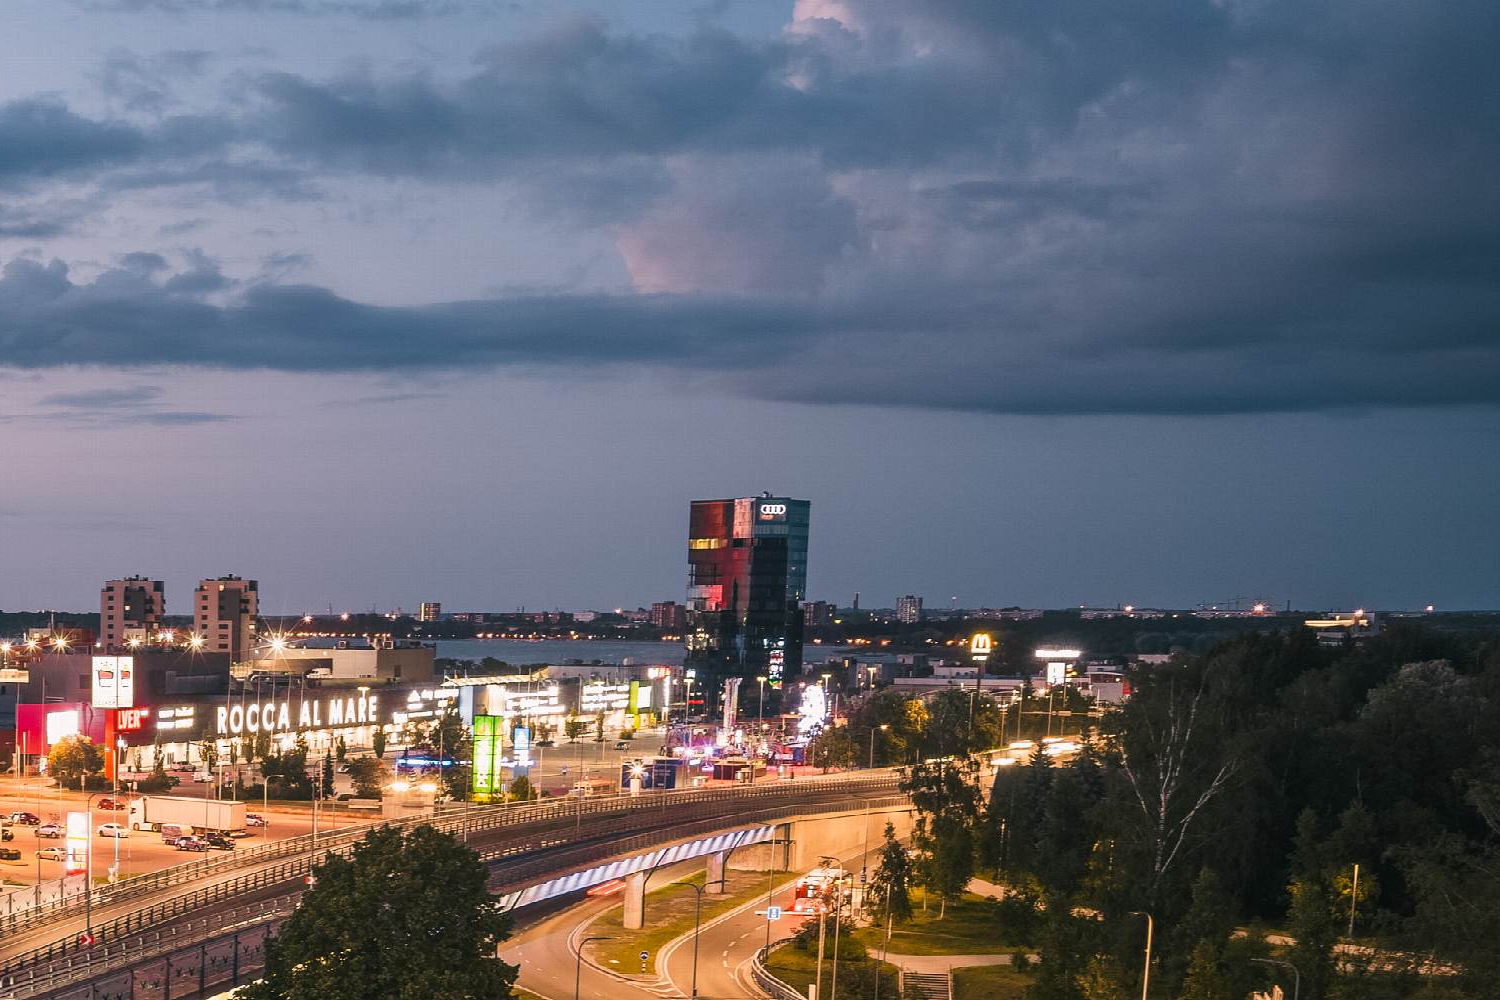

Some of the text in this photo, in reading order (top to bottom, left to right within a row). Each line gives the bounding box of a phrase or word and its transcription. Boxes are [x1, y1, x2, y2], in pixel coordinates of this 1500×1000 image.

[118, 709, 141, 730] LVER
[217, 702, 291, 734] ROCCA
[299, 699, 321, 727] AL
[328, 695, 378, 726] MARE
